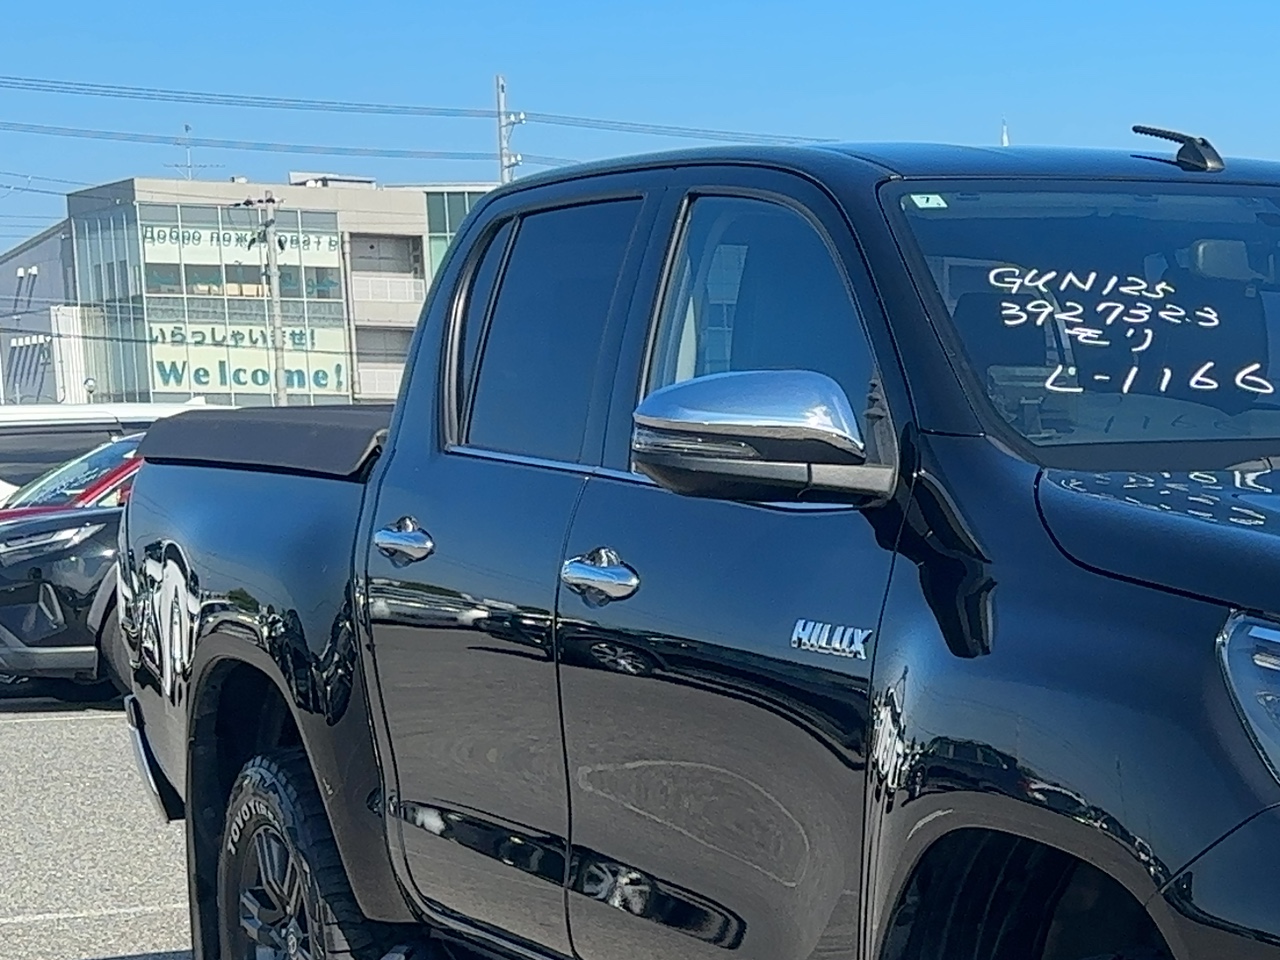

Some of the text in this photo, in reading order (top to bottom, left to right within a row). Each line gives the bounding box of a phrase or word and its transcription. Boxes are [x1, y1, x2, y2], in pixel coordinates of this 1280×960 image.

[210, 231, 340, 251] пожовать
[155, 359, 344, 392] Welcome!
[790, 618, 874, 661] HILUX
